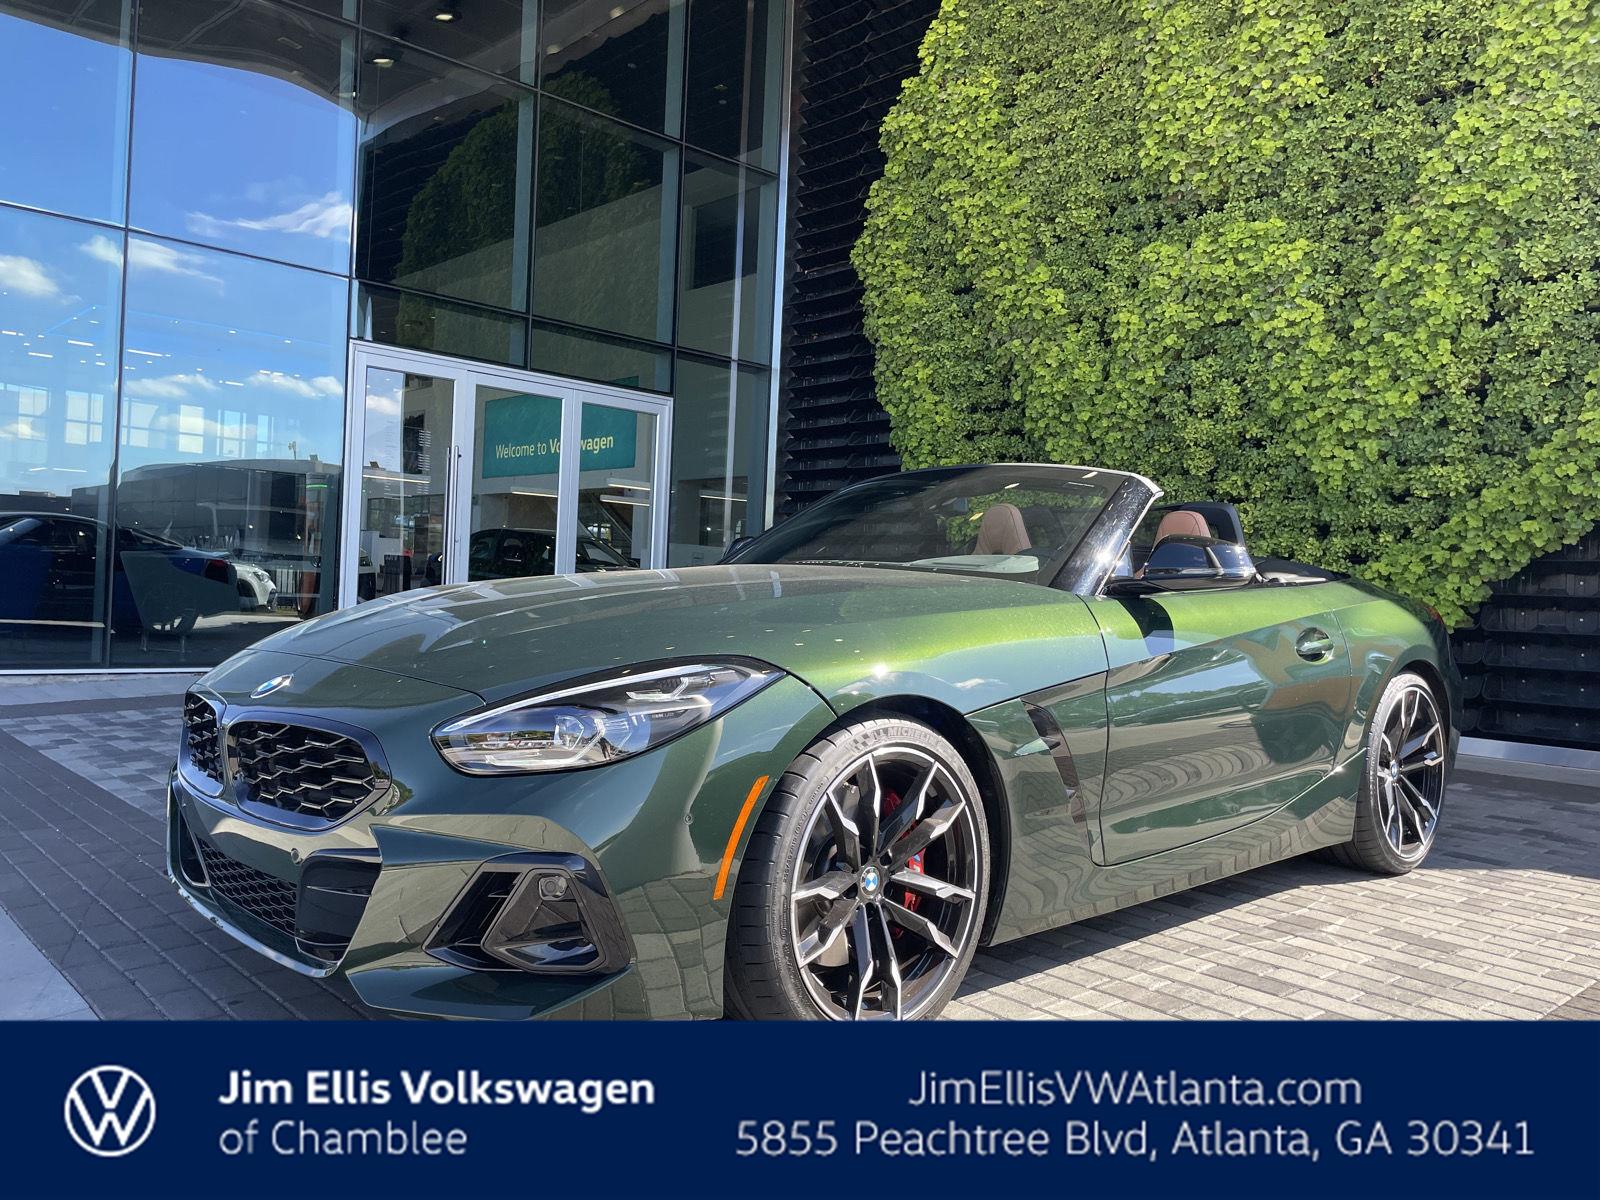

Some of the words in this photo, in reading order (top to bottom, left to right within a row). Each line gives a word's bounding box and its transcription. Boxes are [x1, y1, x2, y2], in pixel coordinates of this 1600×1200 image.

[495, 442, 535, 460] Welcome
[537, 442, 548, 456] to
[549, 436, 614, 454] Vowagen
